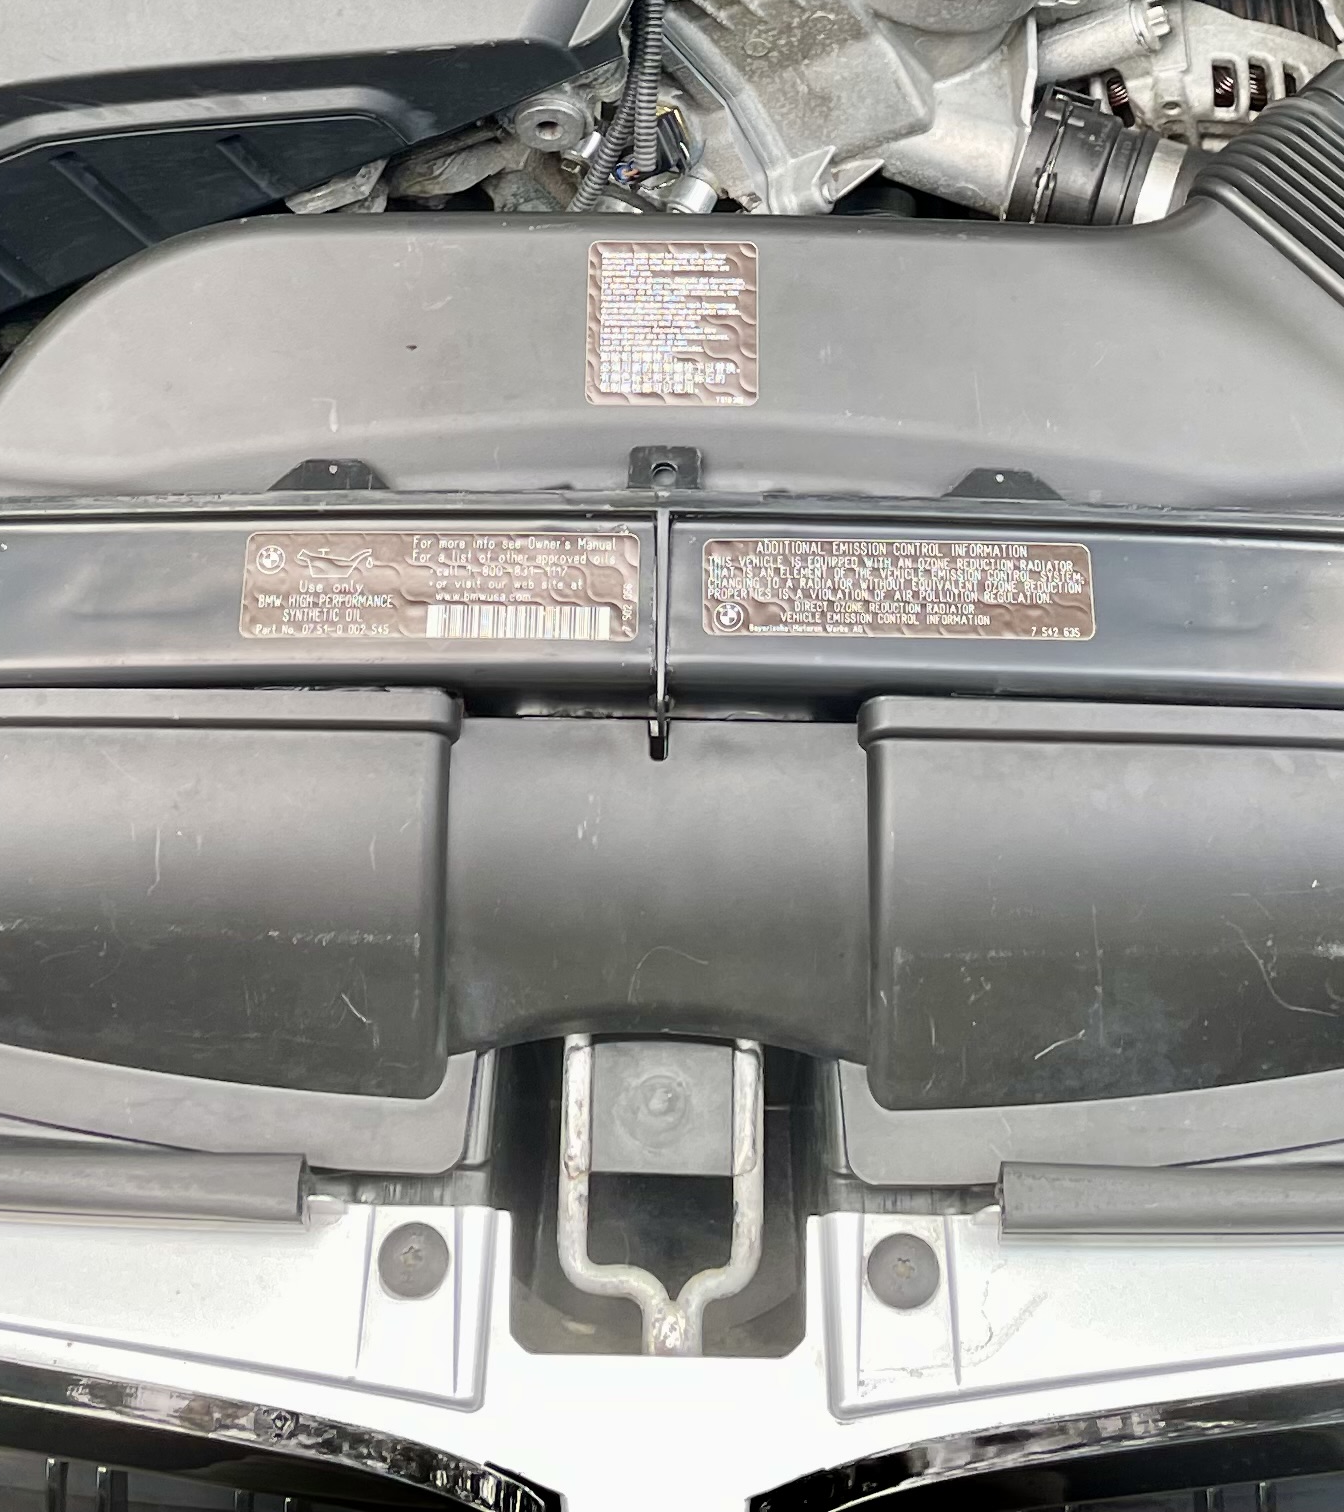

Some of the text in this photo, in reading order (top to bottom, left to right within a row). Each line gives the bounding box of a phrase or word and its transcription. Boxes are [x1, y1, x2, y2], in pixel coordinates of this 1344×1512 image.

[413, 537, 616, 551] For more info see Owner's Manual
[757, 541, 1027, 557] ADDITIONAL EMISSION CONTROL INFORMATION
[413, 550, 616, 565] For a list of other approved oils
[708, 556, 731, 567] THIS
[739, 556, 783, 567] VEHICLE
[791, 557, 801, 567] IS
[808, 557, 858, 568] EQUIPPED
[864, 558, 891, 568] WITH
[898, 559, 912, 569] AN
[918, 559, 949, 569] OZONE
[957, 560, 1014, 570] REDUCTION
[708, 567, 734, 578] THAT
[743, 567, 753, 578] IS
[760, 567, 774, 578] AN
[780, 567, 827, 578] ELEMENT
[834, 568, 846, 578] OF
[855, 568, 872, 578] THE
[880, 568, 924, 580] VEHICLE
[932, 569, 981, 581] EMISSION
[987, 570, 1031, 581] CONTROL
[300, 580, 364, 595] Use only
[455, 579, 480, 589] visit
[489, 581, 505, 589] our
[514, 580, 534, 589] web
[542, 580, 563, 590] site
[571, 580, 583, 590] at
[708, 578, 1082, 594] CHANGING TO A RADIATOR WITHOUT EQUIVALENT OZONE REDUCTION
[258, 595, 393, 608] BMW HIGH PERFORMANCE
[436, 592, 531, 602] www.bmwusa.com
[708, 588, 771, 599] PROPERTIES
[778, 589, 788, 599] IS
[796, 589, 804, 599] A
[810, 589, 868, 600] VIOLATION
[874, 590, 886, 600] OF
[893, 590, 913, 601] AIR
[919, 591, 978, 602] POLLUTION
[794, 601, 974, 613] DIRECT OZONE REDUCTION RADIATOR
[283, 609, 362, 622] SYNTHETIC OIL
[780, 612, 990, 625] VEHICLE EMISSION CONTROL INFORMATION
[256, 624, 276, 634] Part
[348, 625, 365, 634] 002
[1031, 627, 1080, 637] 7 542 635
